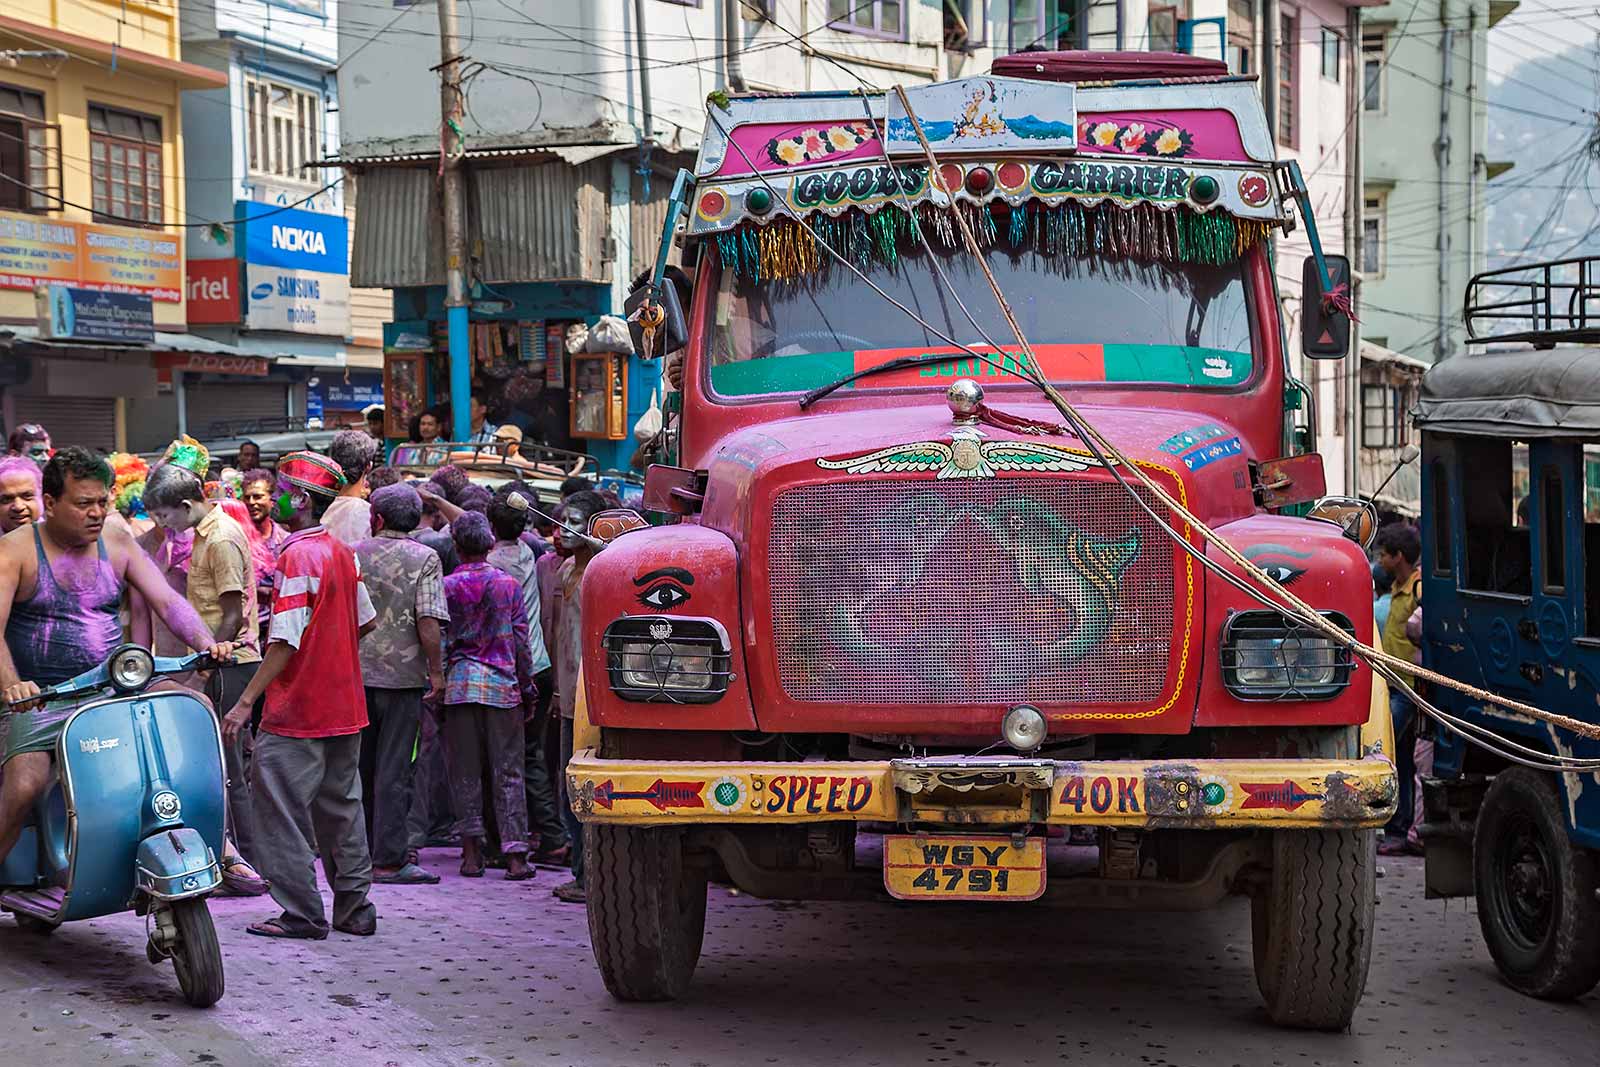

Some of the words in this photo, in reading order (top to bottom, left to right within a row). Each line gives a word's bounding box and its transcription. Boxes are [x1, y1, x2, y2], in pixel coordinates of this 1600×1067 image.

[794, 164, 926, 206] GOODS
[1031, 161, 1190, 200] CARRIER
[272, 225, 327, 255] NOKIA
[277, 276, 321, 299] SAMSUNG
[287, 304, 316, 324] mobile
[767, 776, 873, 814] SPEED
[922, 845, 1009, 867] WGY
[912, 868, 1009, 893] 4791
